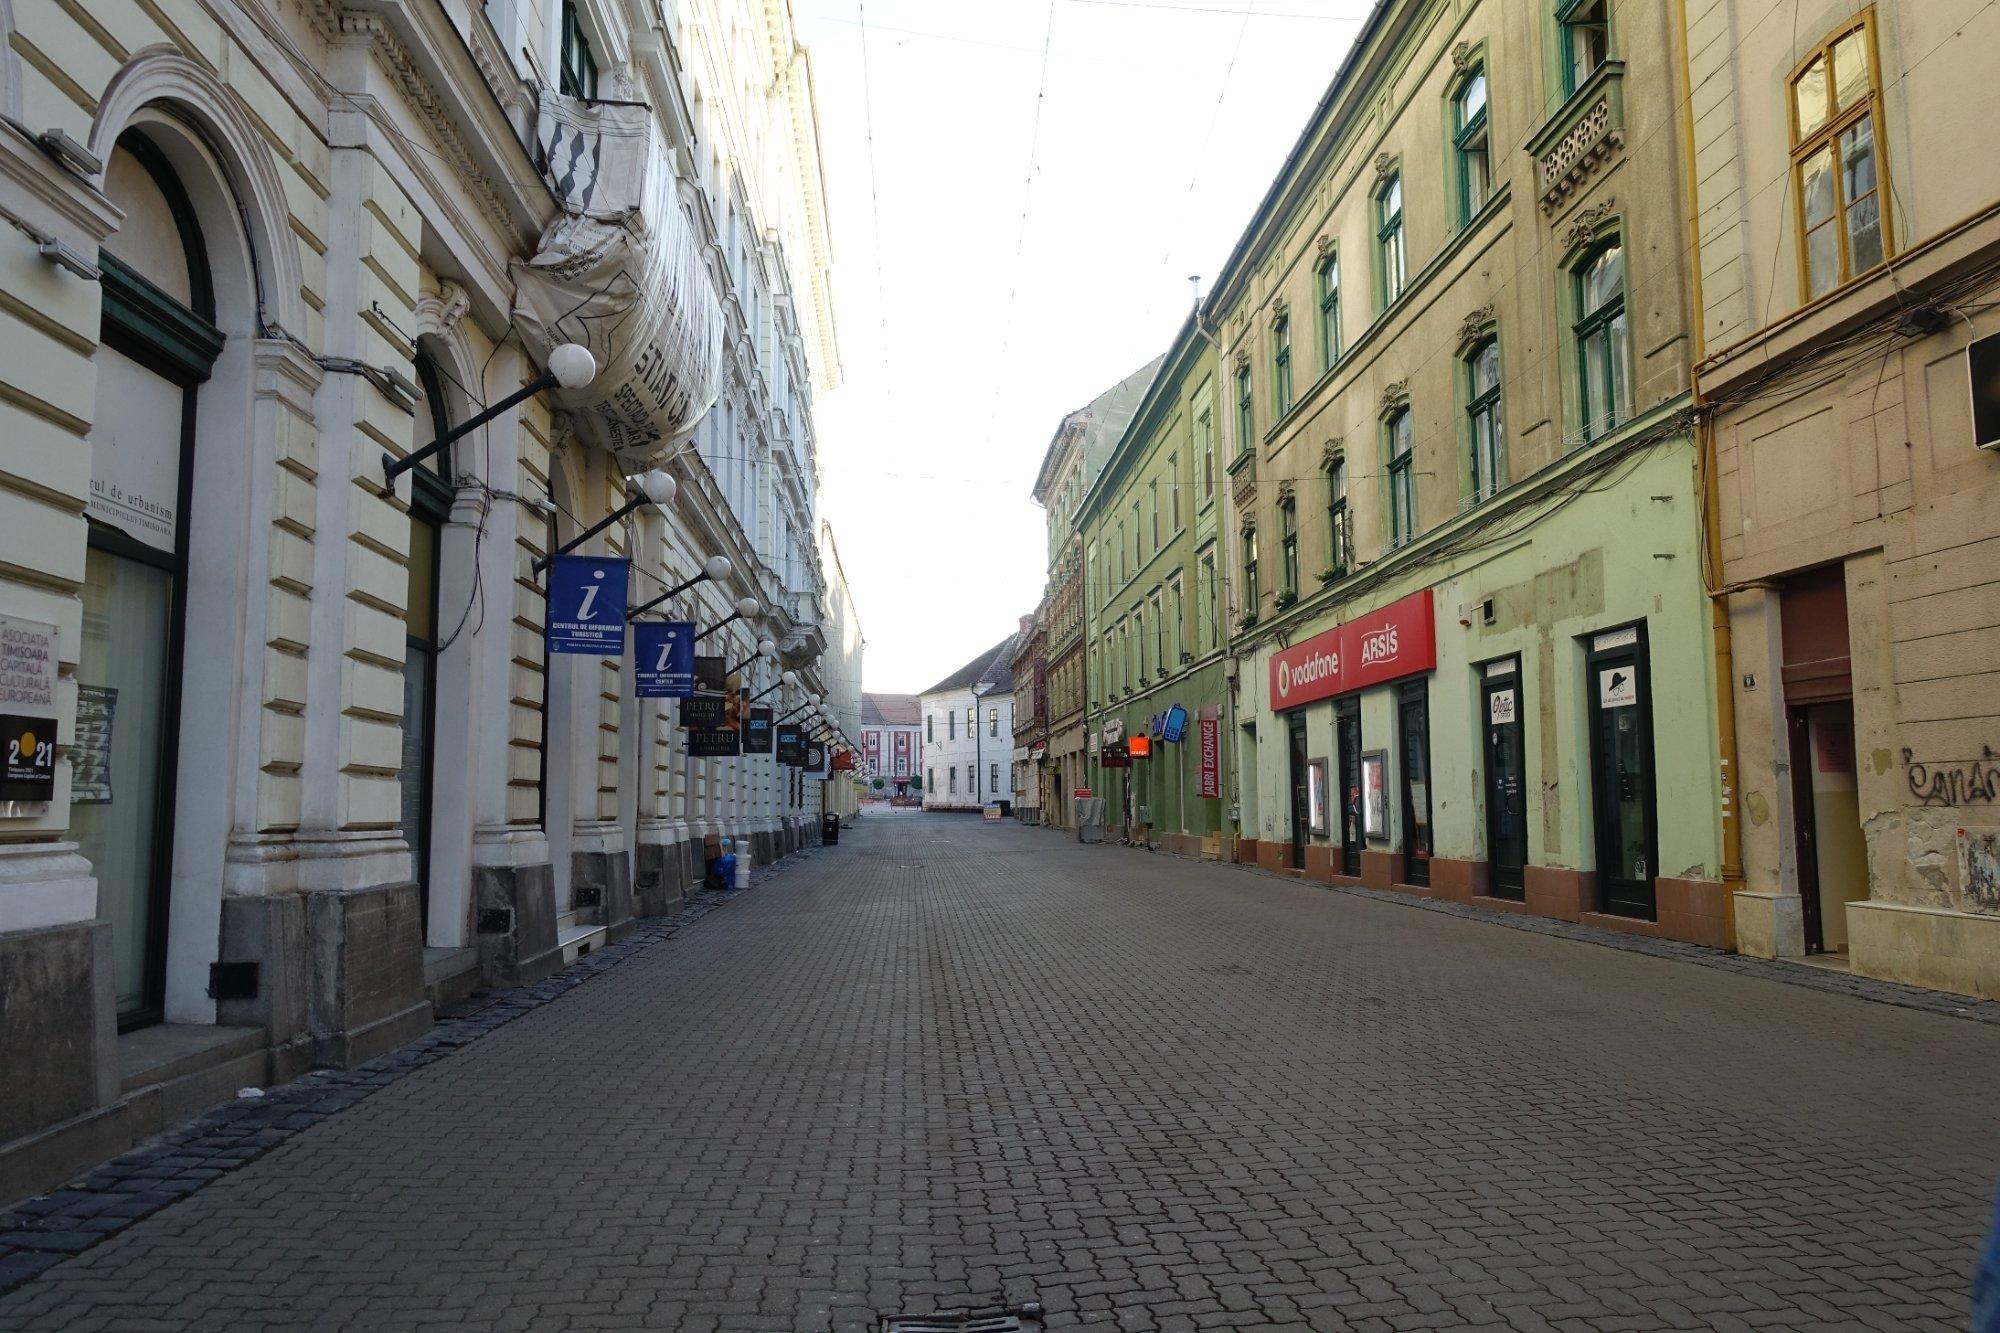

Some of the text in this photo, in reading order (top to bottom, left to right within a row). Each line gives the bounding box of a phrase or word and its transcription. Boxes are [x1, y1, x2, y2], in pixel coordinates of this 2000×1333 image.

[111, 484, 122, 499] de
[128, 494, 172, 520] urbanism
[1361, 629, 1398, 663] ARSIS
[1291, 651, 1339, 686] vodafone
[1203, 721, 1217, 797] JABRI EXCHANGE
